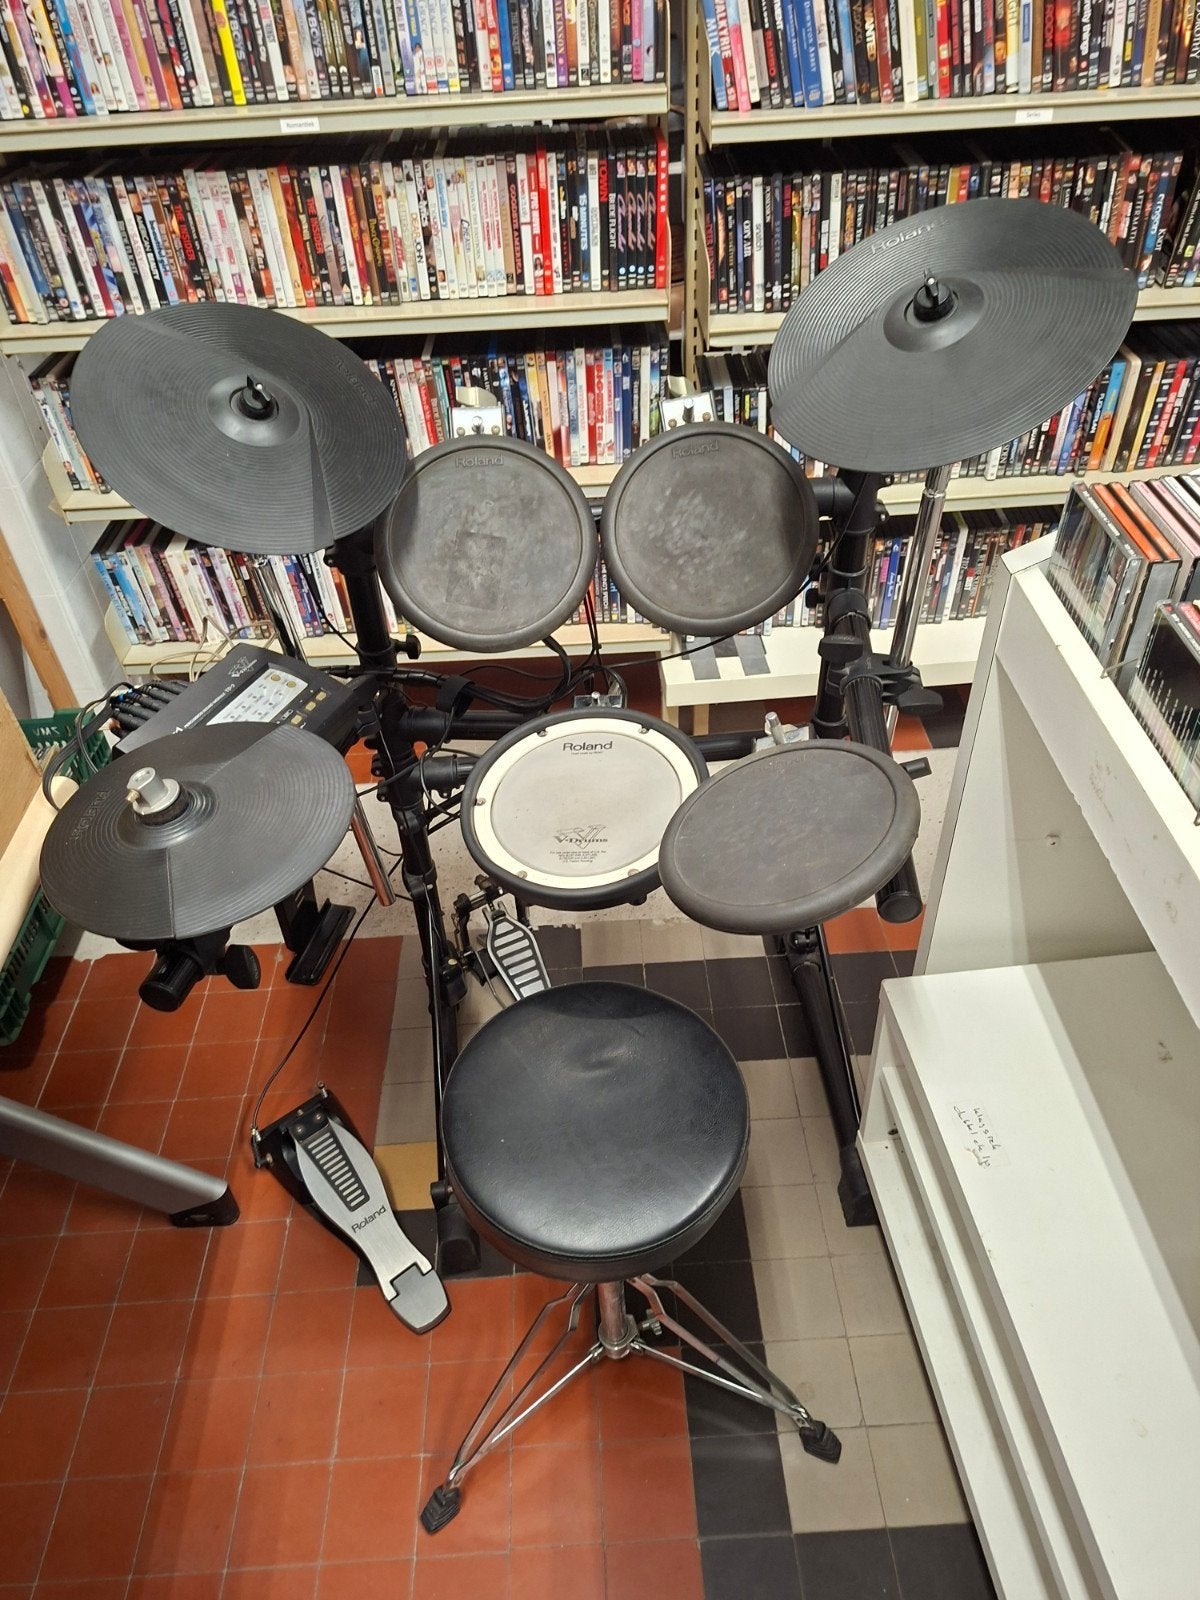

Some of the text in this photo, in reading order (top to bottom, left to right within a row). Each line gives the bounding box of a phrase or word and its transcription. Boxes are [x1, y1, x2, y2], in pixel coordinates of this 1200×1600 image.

[706, 18, 720, 57] MILK
[803, 1, 817, 72] DOWNTON ABBEY
[599, 160, 609, 202] TOWN
[306, 197, 317, 215] THE
[530, 192, 539, 209] EPIC
[1128, 188, 1145, 244] AFTERMATH
[174, 204, 196, 260] THE INSIDER
[311, 217, 324, 255] INSIDER
[411, 212, 424, 263] DEAR JOHN
[509, 184, 522, 275] GOODBYE AMERICA
[579, 193, 588, 251] 15 MINUTES
[608, 193, 617, 249] BRIDE FLIGHT
[743, 219, 752, 257] CON AIR
[755, 223, 764, 251] snatch
[1154, 228, 1167, 252] KNOT
[454, 453, 504, 468] Roland
[562, 740, 613, 752] Roland
[351, 1205, 387, 1233] Roland
